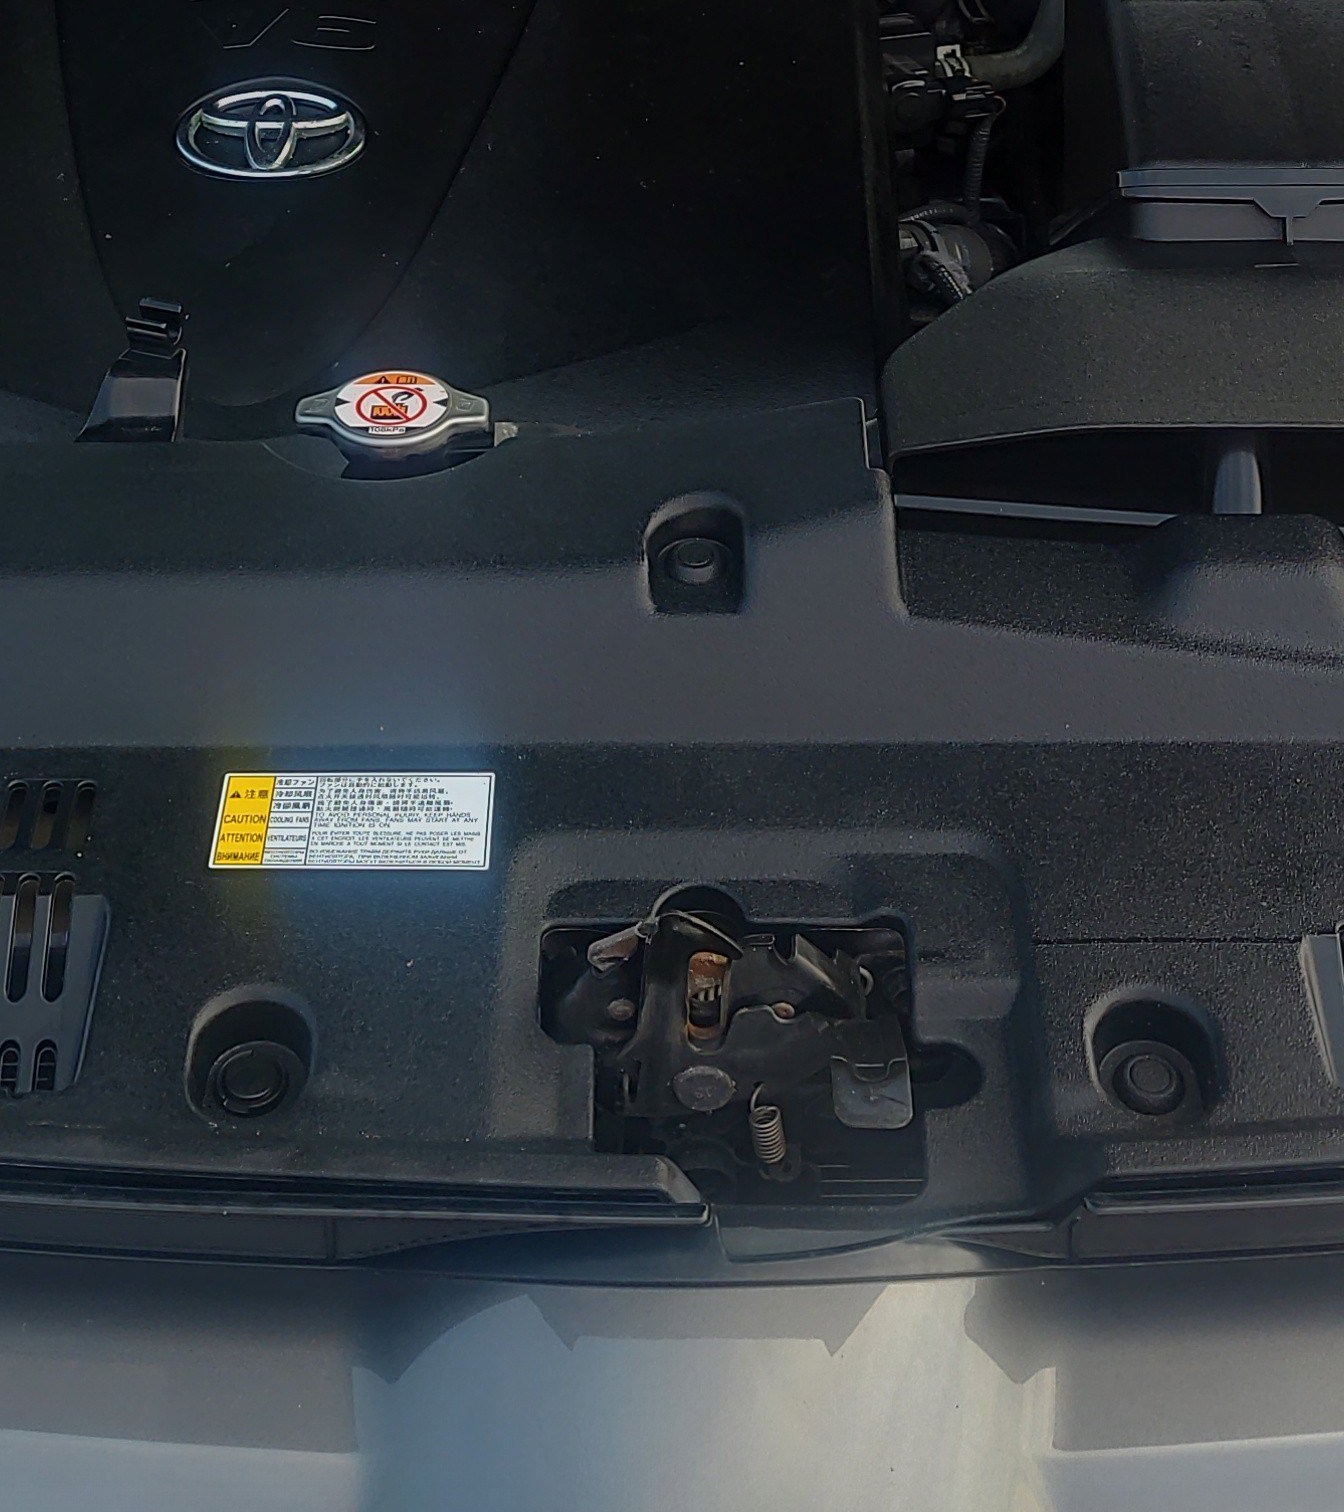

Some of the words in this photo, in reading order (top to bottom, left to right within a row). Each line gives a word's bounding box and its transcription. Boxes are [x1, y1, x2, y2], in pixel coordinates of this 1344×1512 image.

[244, 789, 269, 799] 注意
[224, 815, 266, 824] CAUTION
[269, 816, 294, 824] COOLING
[296, 816, 310, 824] FANS
[219, 833, 264, 842] ATTENTION
[216, 851, 260, 861] ВНИМАНИЕ
